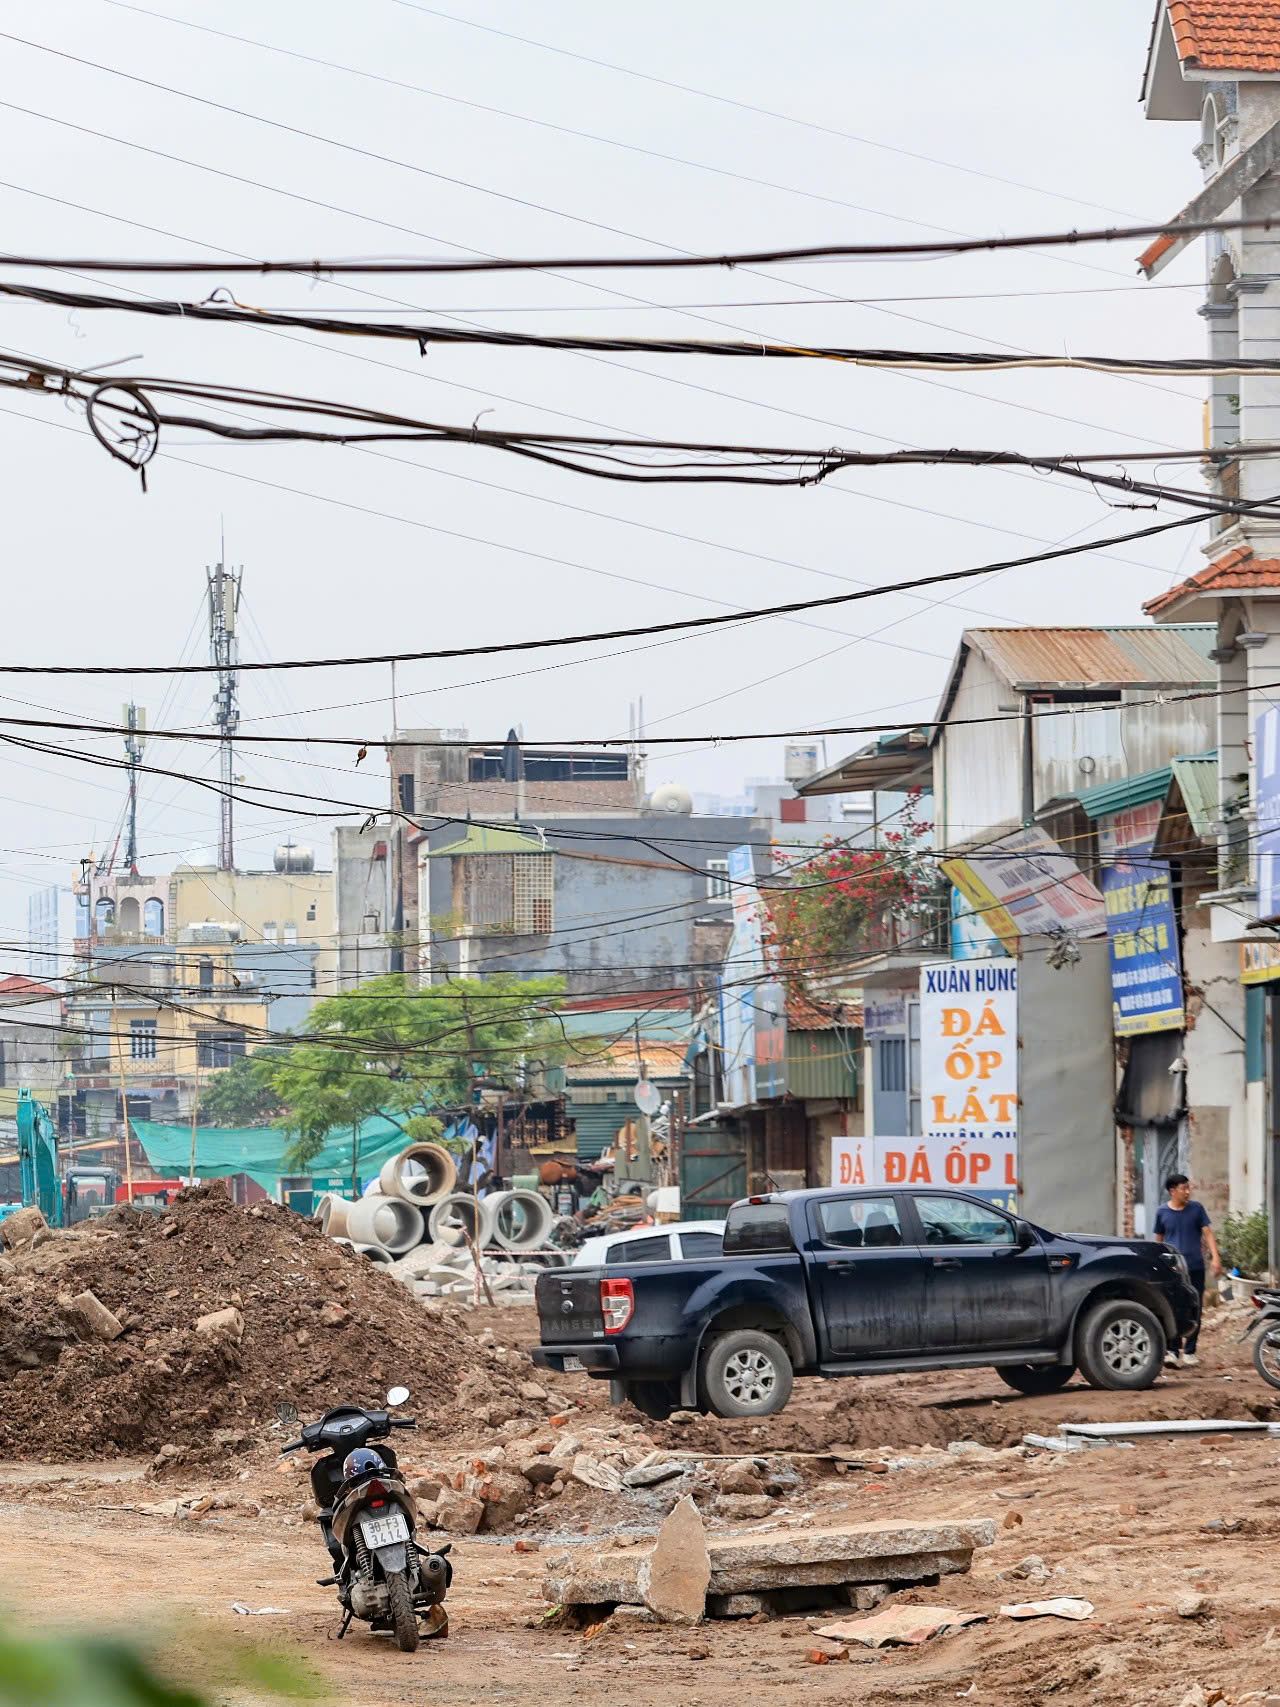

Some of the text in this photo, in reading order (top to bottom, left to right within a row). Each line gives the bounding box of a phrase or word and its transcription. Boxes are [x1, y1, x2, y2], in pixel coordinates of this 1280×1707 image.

[926, 966, 970, 993] XUÂN
[940, 999, 1006, 1037] ĐÁ
[945, 1037, 1003, 1080] ỐP
[931, 1086, 1017, 1124] LÁT
[839, 1144, 865, 1185] ĐÁ
[884, 1145, 932, 1184] ĐÁ
[945, 1141, 991, 1184] ỐP
